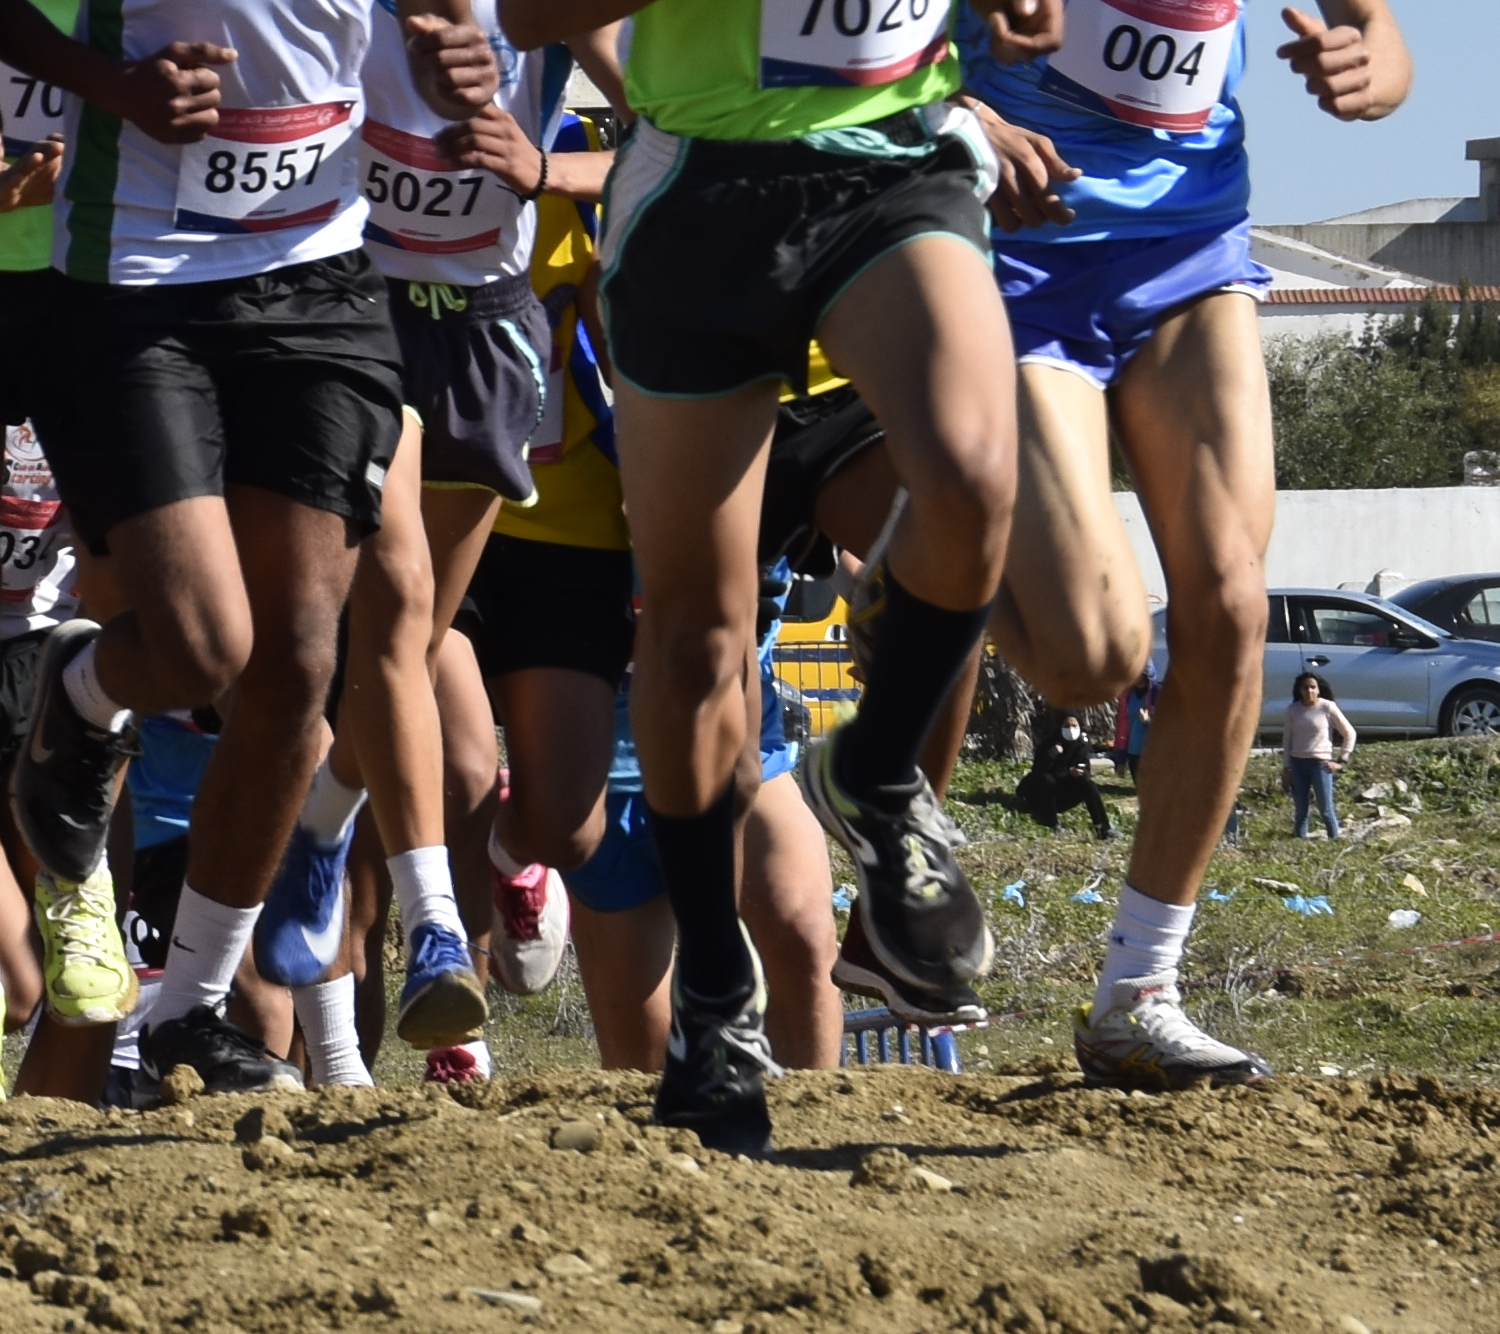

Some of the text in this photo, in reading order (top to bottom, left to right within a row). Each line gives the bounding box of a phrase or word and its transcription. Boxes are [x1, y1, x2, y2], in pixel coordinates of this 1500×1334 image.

[1102, 23, 1207, 87] 004
[204, 142, 326, 194] 8557
[364, 161, 485, 217] 5027
